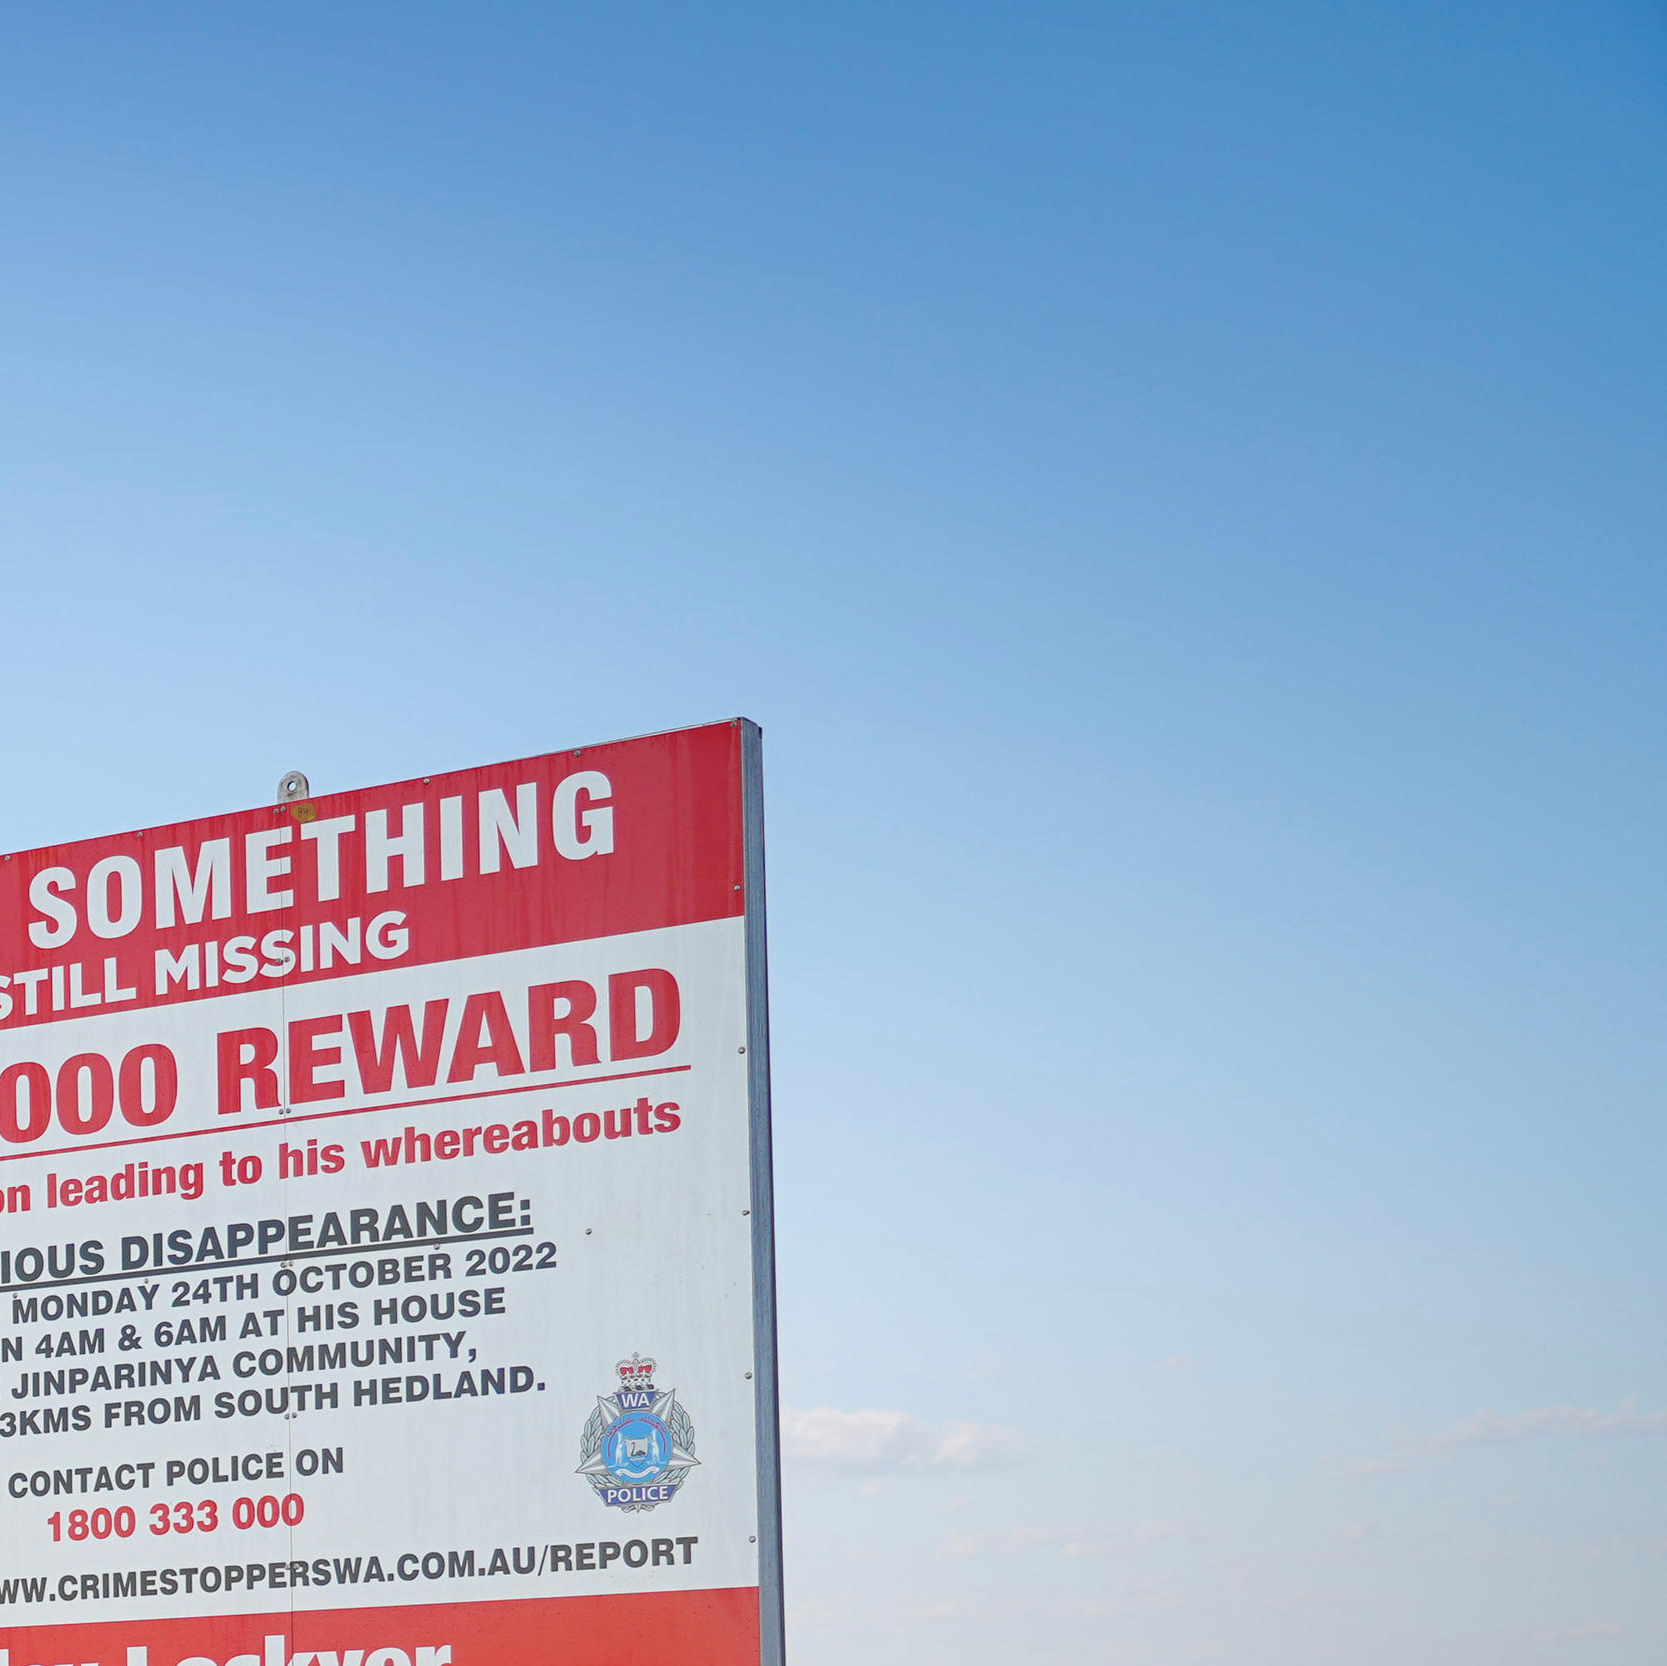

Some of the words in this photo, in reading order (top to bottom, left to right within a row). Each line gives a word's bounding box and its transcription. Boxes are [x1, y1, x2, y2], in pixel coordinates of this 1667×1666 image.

[27, 770, 614, 950] SOMETHING
[155, 910, 409, 996] MISSING
[216, 967, 681, 1115] REWARD
[46, 1160, 204, 1208] leading
[219, 1151, 262, 1187] to
[279, 1138, 345, 1180] his
[360, 1097, 682, 1169] whereabouts
[121, 1191, 531, 1271] DISAPPEARANCE:
[12, 1283, 160, 1324] MONDAY
[171, 1273, 259, 1308] 24TH
[272, 1252, 452, 1296] OCTOBER
[465, 1241, 557, 1277] 2022
[35, 1328, 105, 1358] 4AM
[118, 1324, 142, 1351] &
[154, 1315, 226, 1347] 6AM
[239, 1309, 284, 1339] AT
[297, 1302, 359, 1333] HIS
[373, 1287, 506, 1326] HOUSE
[11, 1355, 221, 1400] JINPARINYA
[232, 1331, 476, 1379] COMMUNITY,
[104, 1394, 200, 1428] FROM
[214, 1382, 339, 1419] SOUTH
[353, 1365, 546, 1407] HEDLAND.
[621, 1392, 650, 1408] WA
[8, 1462, 155, 1499] CONTACT
[166, 1452, 285, 1487] POLICE
[295, 1447, 344, 1477] ON
[606, 1485, 669, 1502] POLICE
[47, 1505, 136, 1543] 1800
[149, 1499, 219, 1537] 333
[232, 1493, 305, 1530] 000
